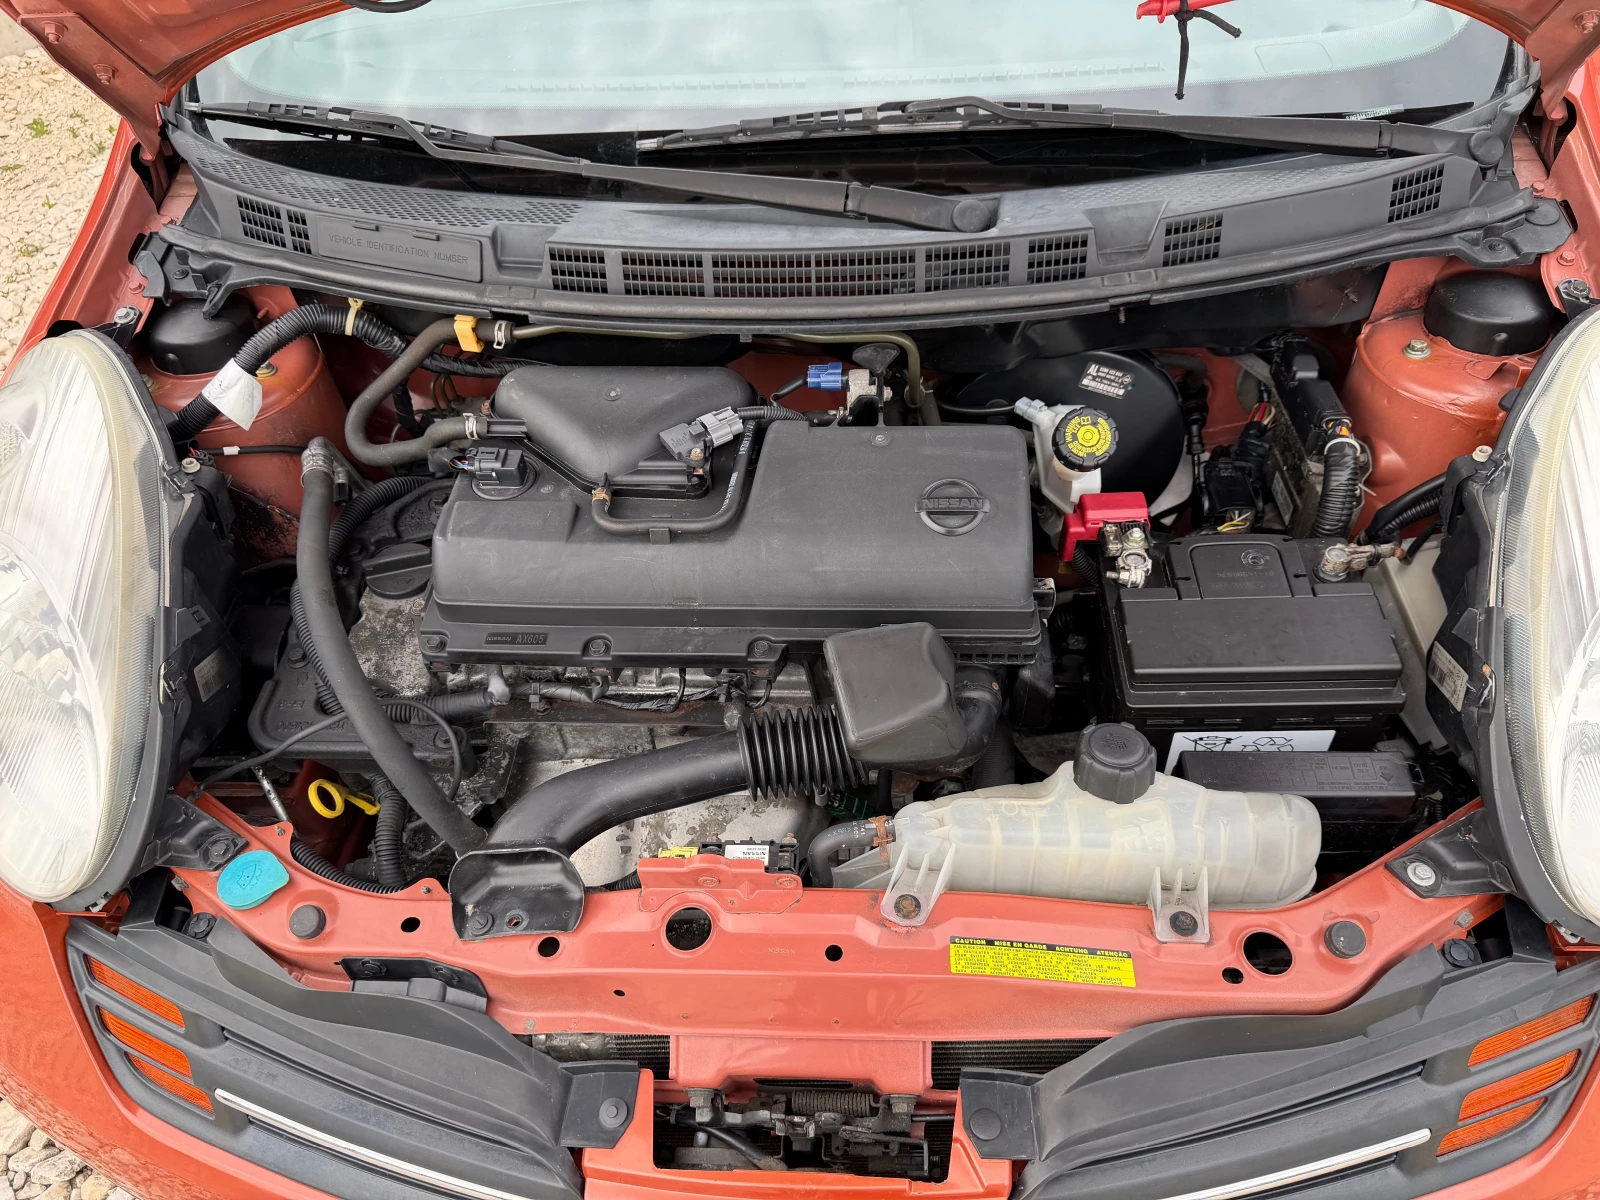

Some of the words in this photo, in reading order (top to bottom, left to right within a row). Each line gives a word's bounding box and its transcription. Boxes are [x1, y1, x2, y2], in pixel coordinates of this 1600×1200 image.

[328, 233, 362, 247] VEHICLE
[366, 240, 430, 258] IDENTIFICATION
[434, 251, 469, 265] NUMBER
[1087, 364, 1099, 376] AL
[1064, 415, 1081, 443] WARNING
[922, 498, 983, 509] NISSAN
[515, 634, 545, 644] AX605
[955, 937, 987, 945] CAUTION
[1055, 946, 1089, 954] ACHTUNG
[1096, 949, 1128, 957] ATENÇÃO
